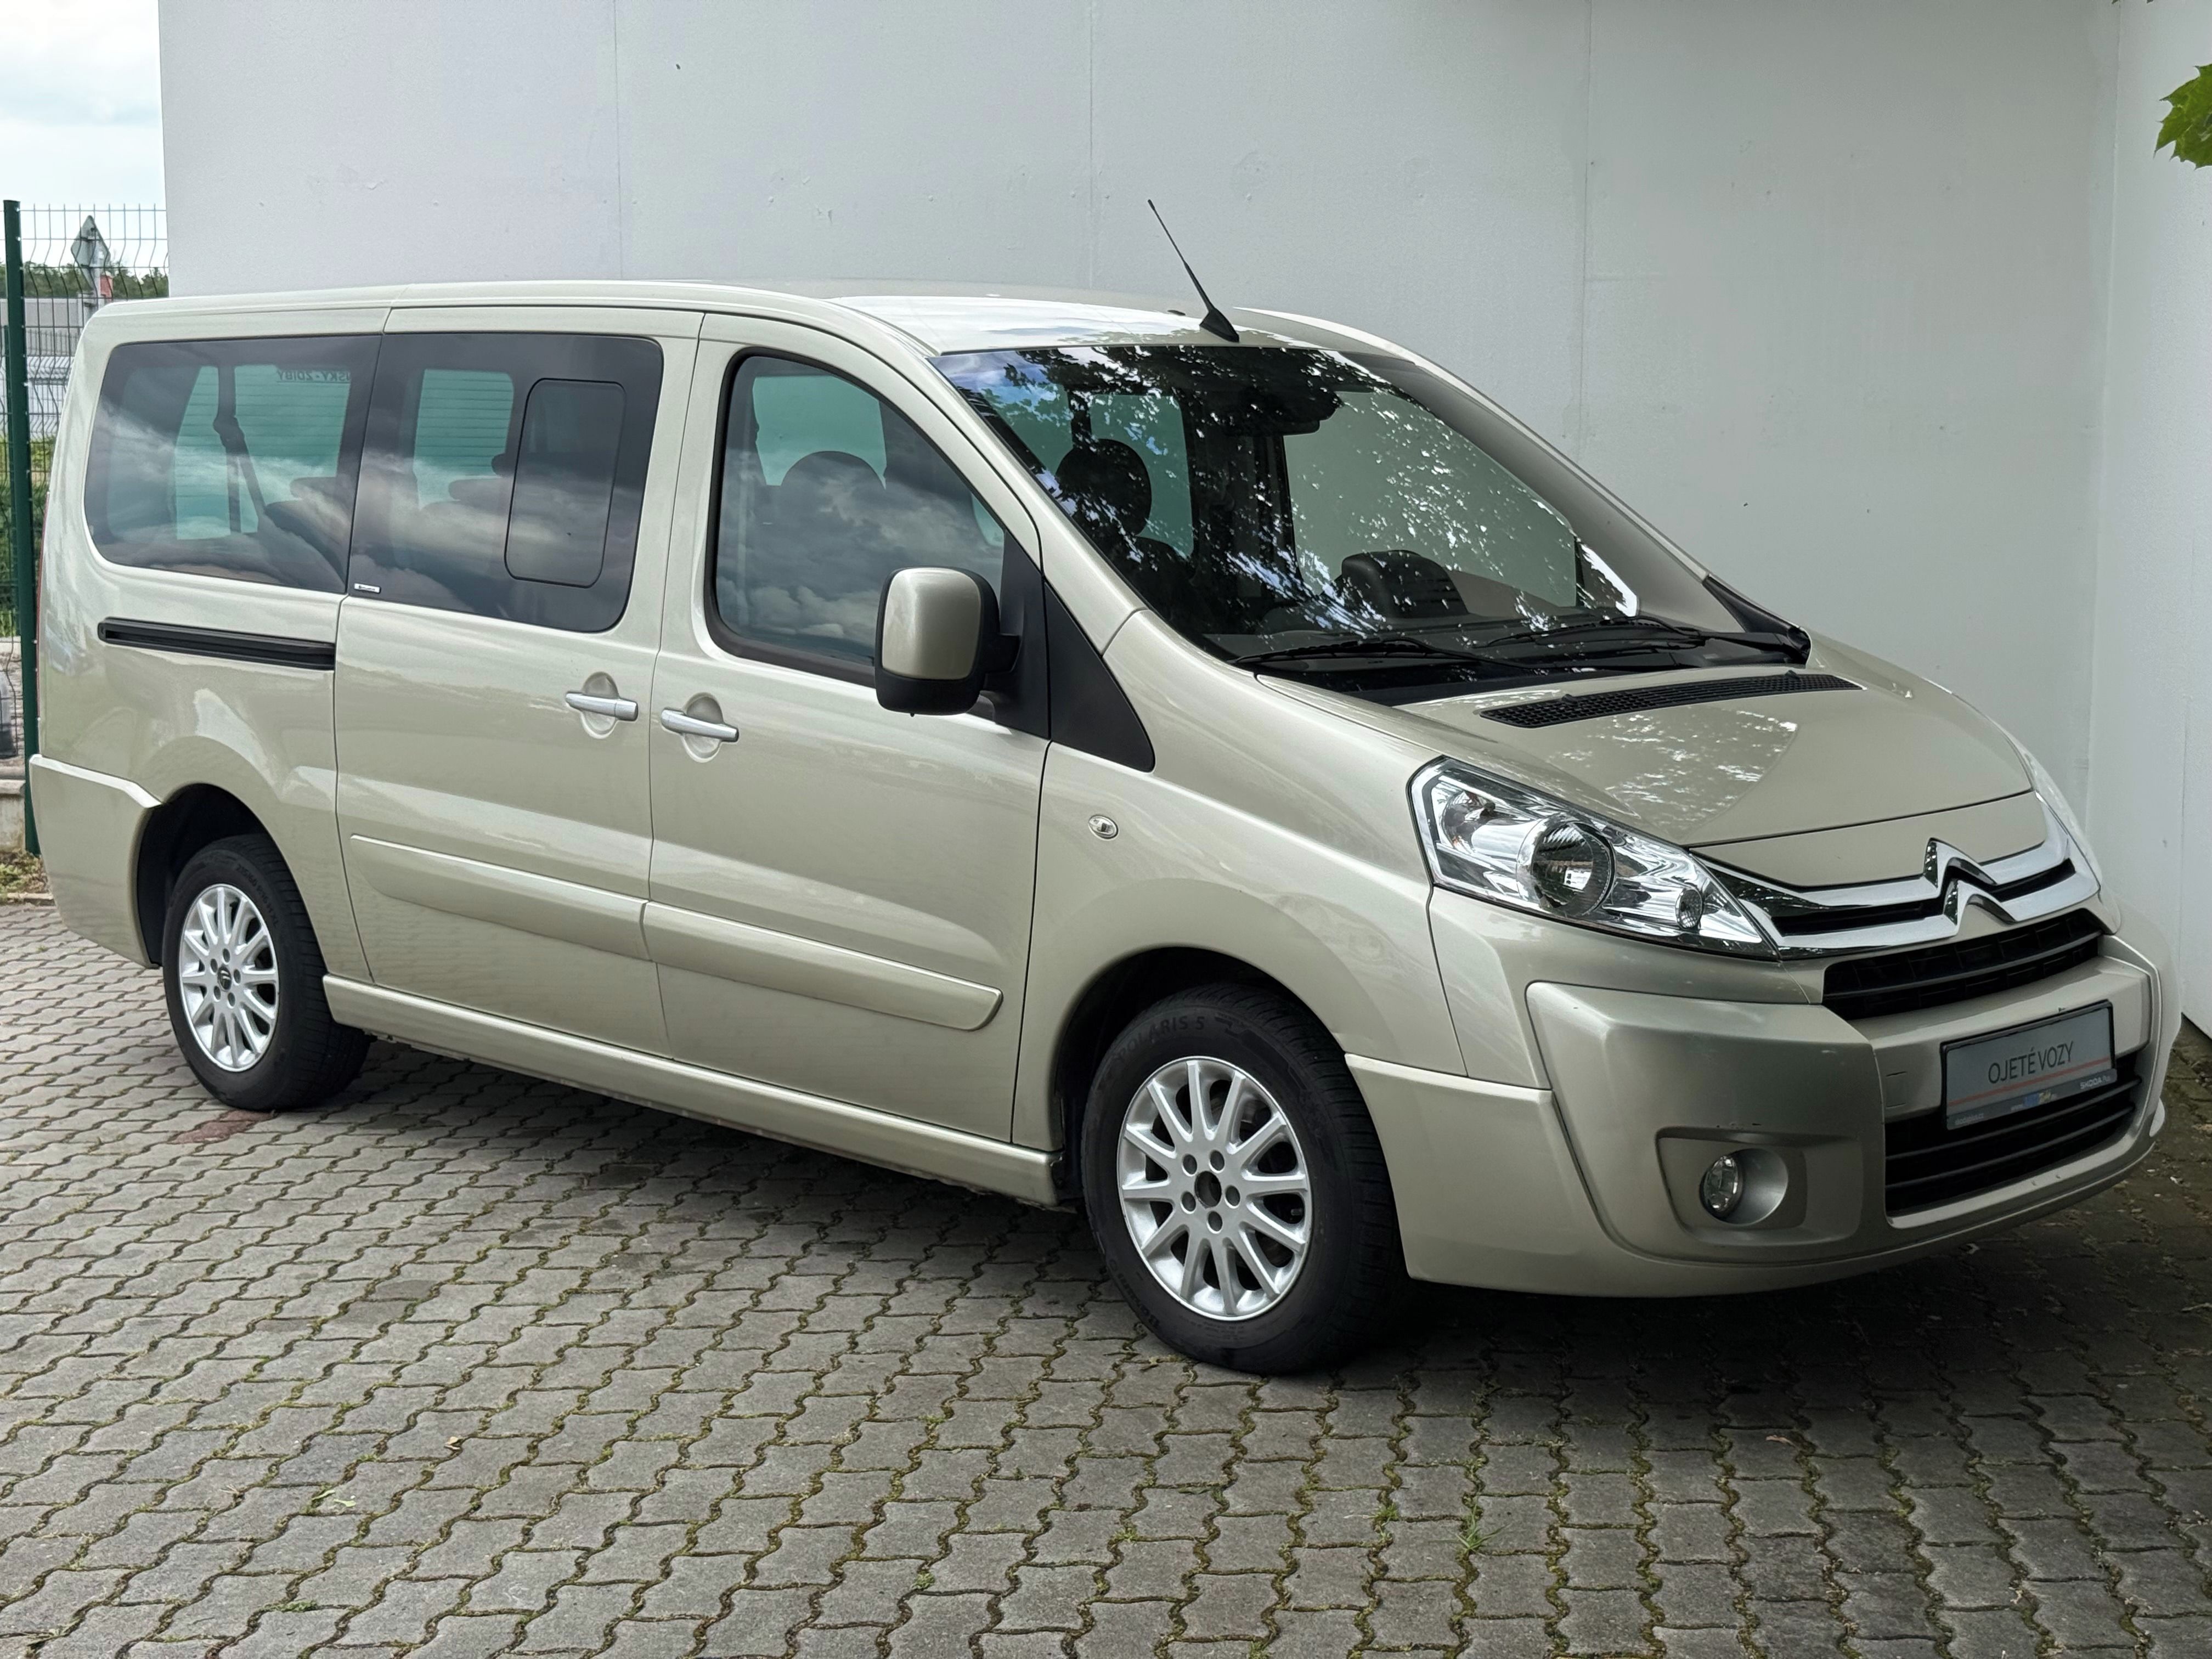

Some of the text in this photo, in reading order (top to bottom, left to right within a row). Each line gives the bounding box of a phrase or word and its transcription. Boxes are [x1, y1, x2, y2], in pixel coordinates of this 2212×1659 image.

[1195, 1015, 1205, 1030] 5
[1988, 1041, 2074, 1084] OJETÉ VOZY
